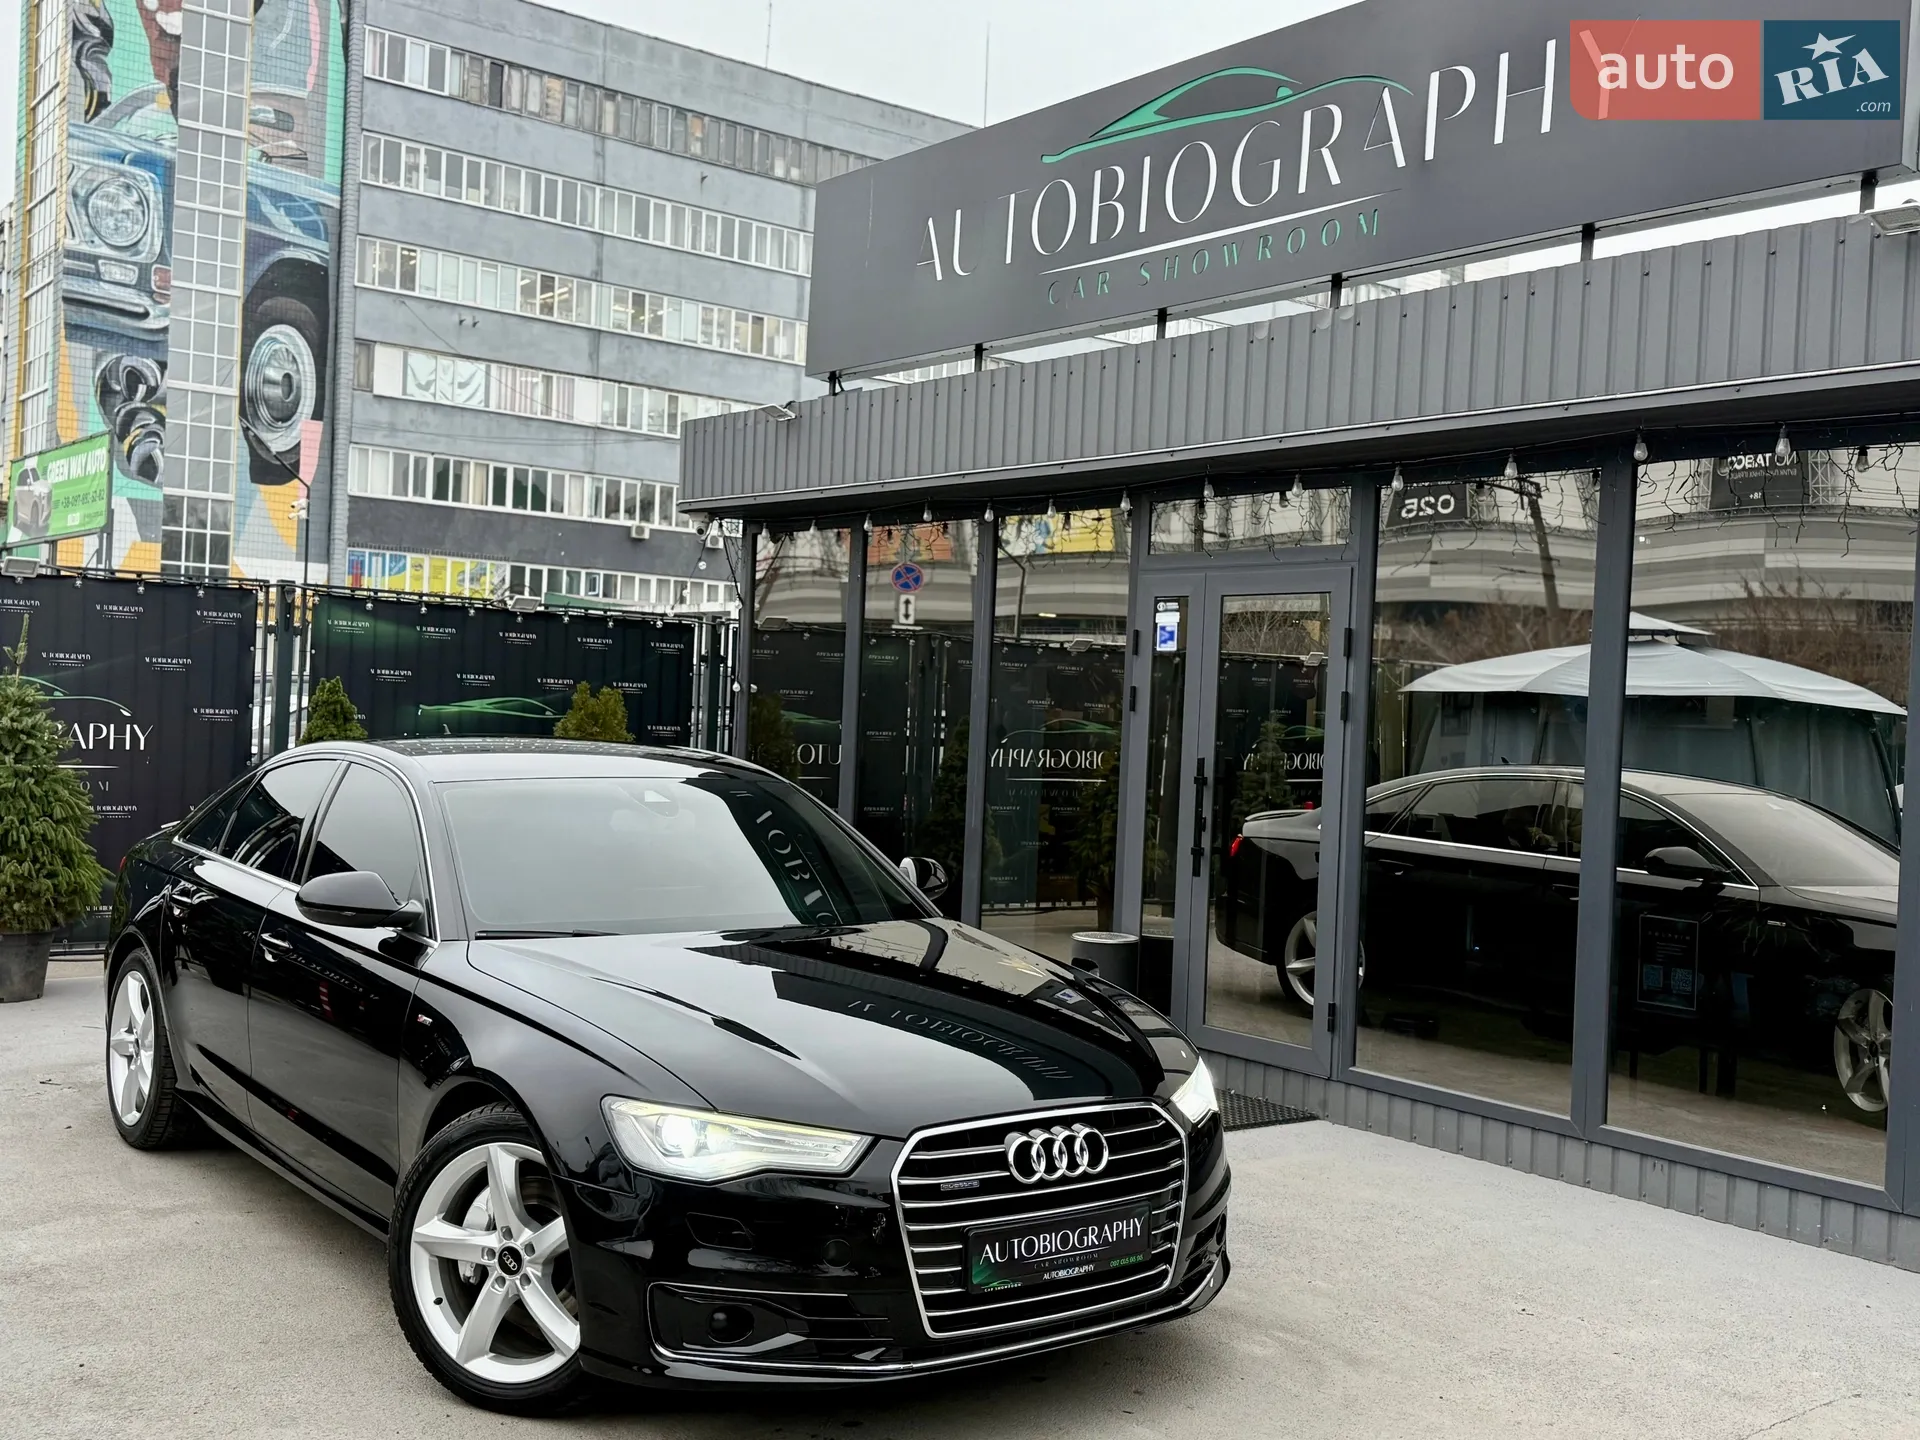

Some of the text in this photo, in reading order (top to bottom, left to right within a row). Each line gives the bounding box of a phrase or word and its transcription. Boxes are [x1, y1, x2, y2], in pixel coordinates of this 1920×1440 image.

[1047, 208, 1381, 306] CAR SHOWROOM
[69, 451, 87, 480] WAY
[979, 1215, 1145, 1265] AUTOBIOGRAPHY
